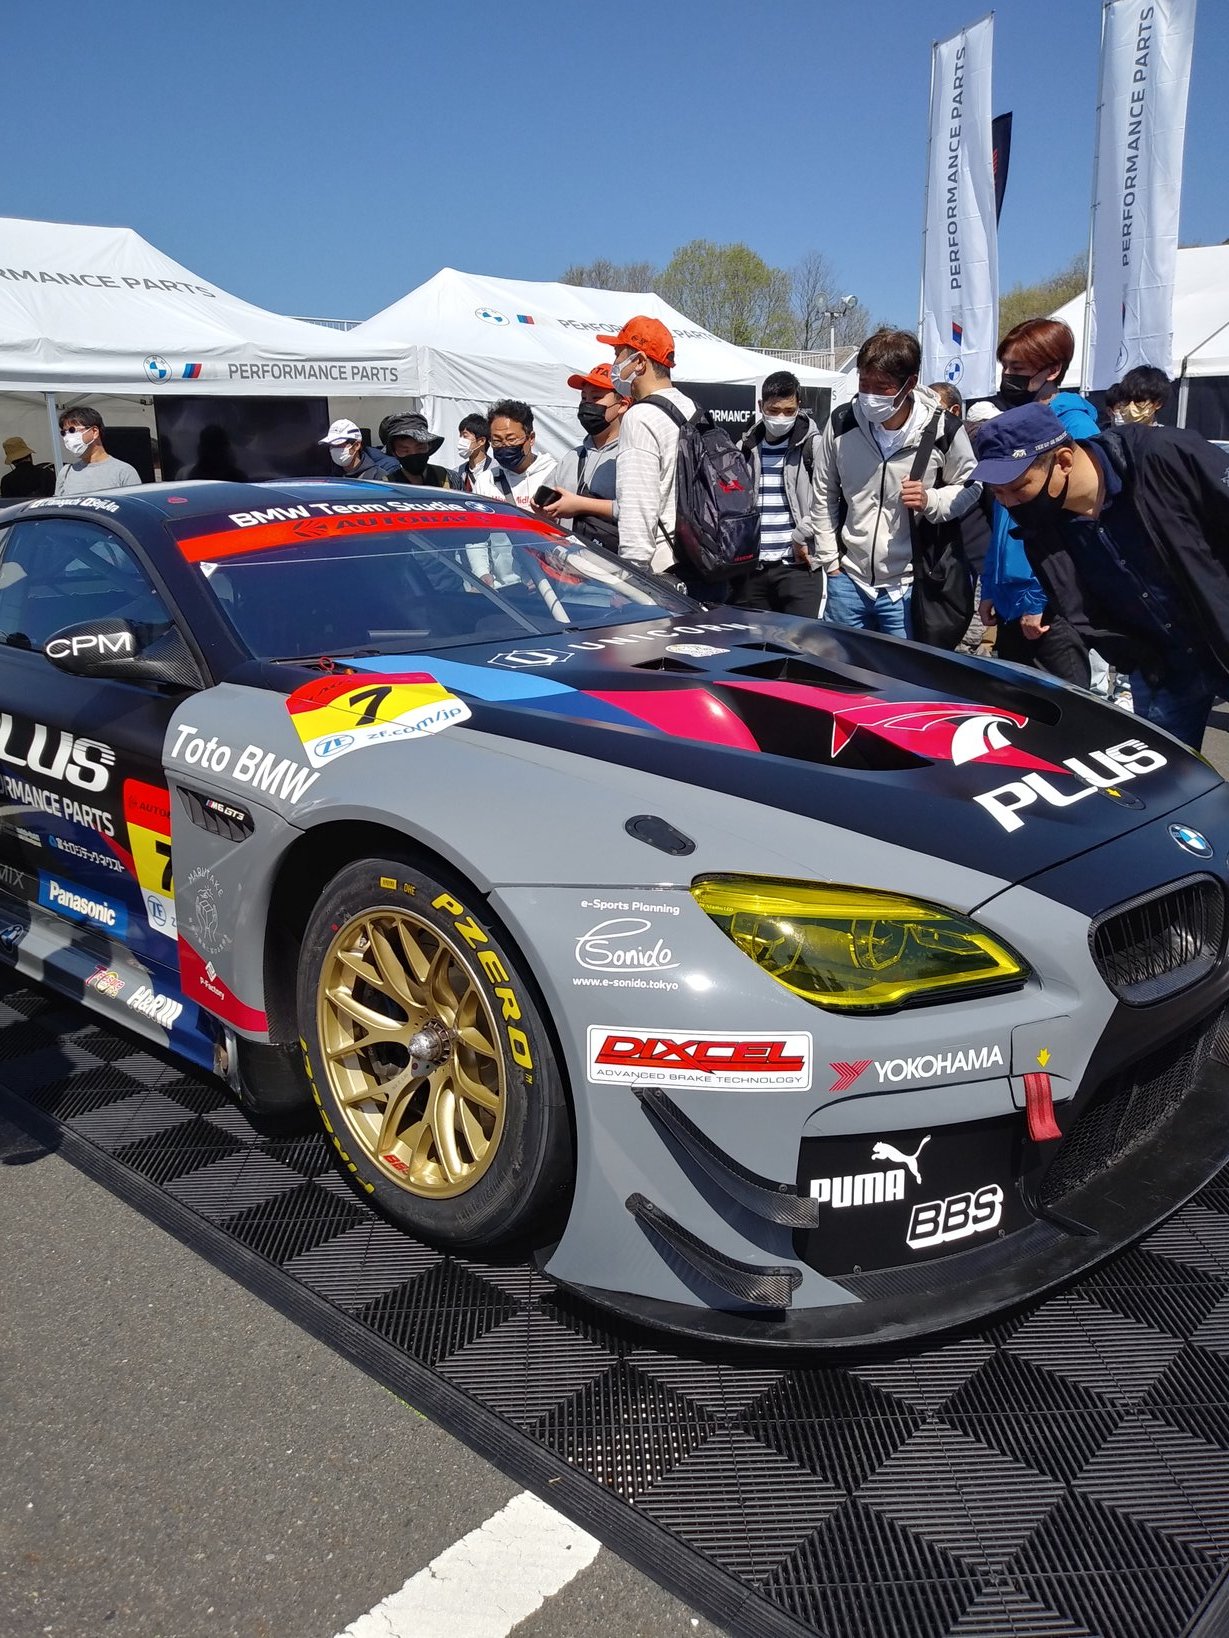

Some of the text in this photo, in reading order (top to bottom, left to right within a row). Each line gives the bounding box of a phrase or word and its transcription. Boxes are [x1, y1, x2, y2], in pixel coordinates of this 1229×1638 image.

[1122, 5, 1155, 267] PERFORMANCE PARTS
[945, 46, 967, 291] PERFORMANCE PARTS
[121, 276, 216, 298] PARTS
[227, 363, 399, 382] PERFORMANCE PARTS
[229, 500, 468, 529] BMW Team Studie
[46, 632, 132, 659] CPM
[567, 621, 757, 650] UNICORN
[349, 686, 393, 727] 7
[367, 706, 462, 740] zf.com/jp
[169, 723, 322, 805] Toto BMW
[972, 738, 1168, 833] PLUS
[63, 797, 115, 837] PARTS
[223, 806, 246, 821] GT3
[155, 839, 173, 892] 7
[49, 879, 116, 926] Panasonic
[581, 898, 681, 916] e-Sports Planning
[572, 977, 679, 992] www.e-sonido.tokyo
[595, 1035, 805, 1074] DIXCEL
[874, 1044, 1004, 1083] YOKOHAMA
[596, 1068, 803, 1085] ADVANCED BRAKE TECHNOLOGY
[810, 1168, 905, 1208] PUMA
[906, 1183, 1004, 1249] BBS
